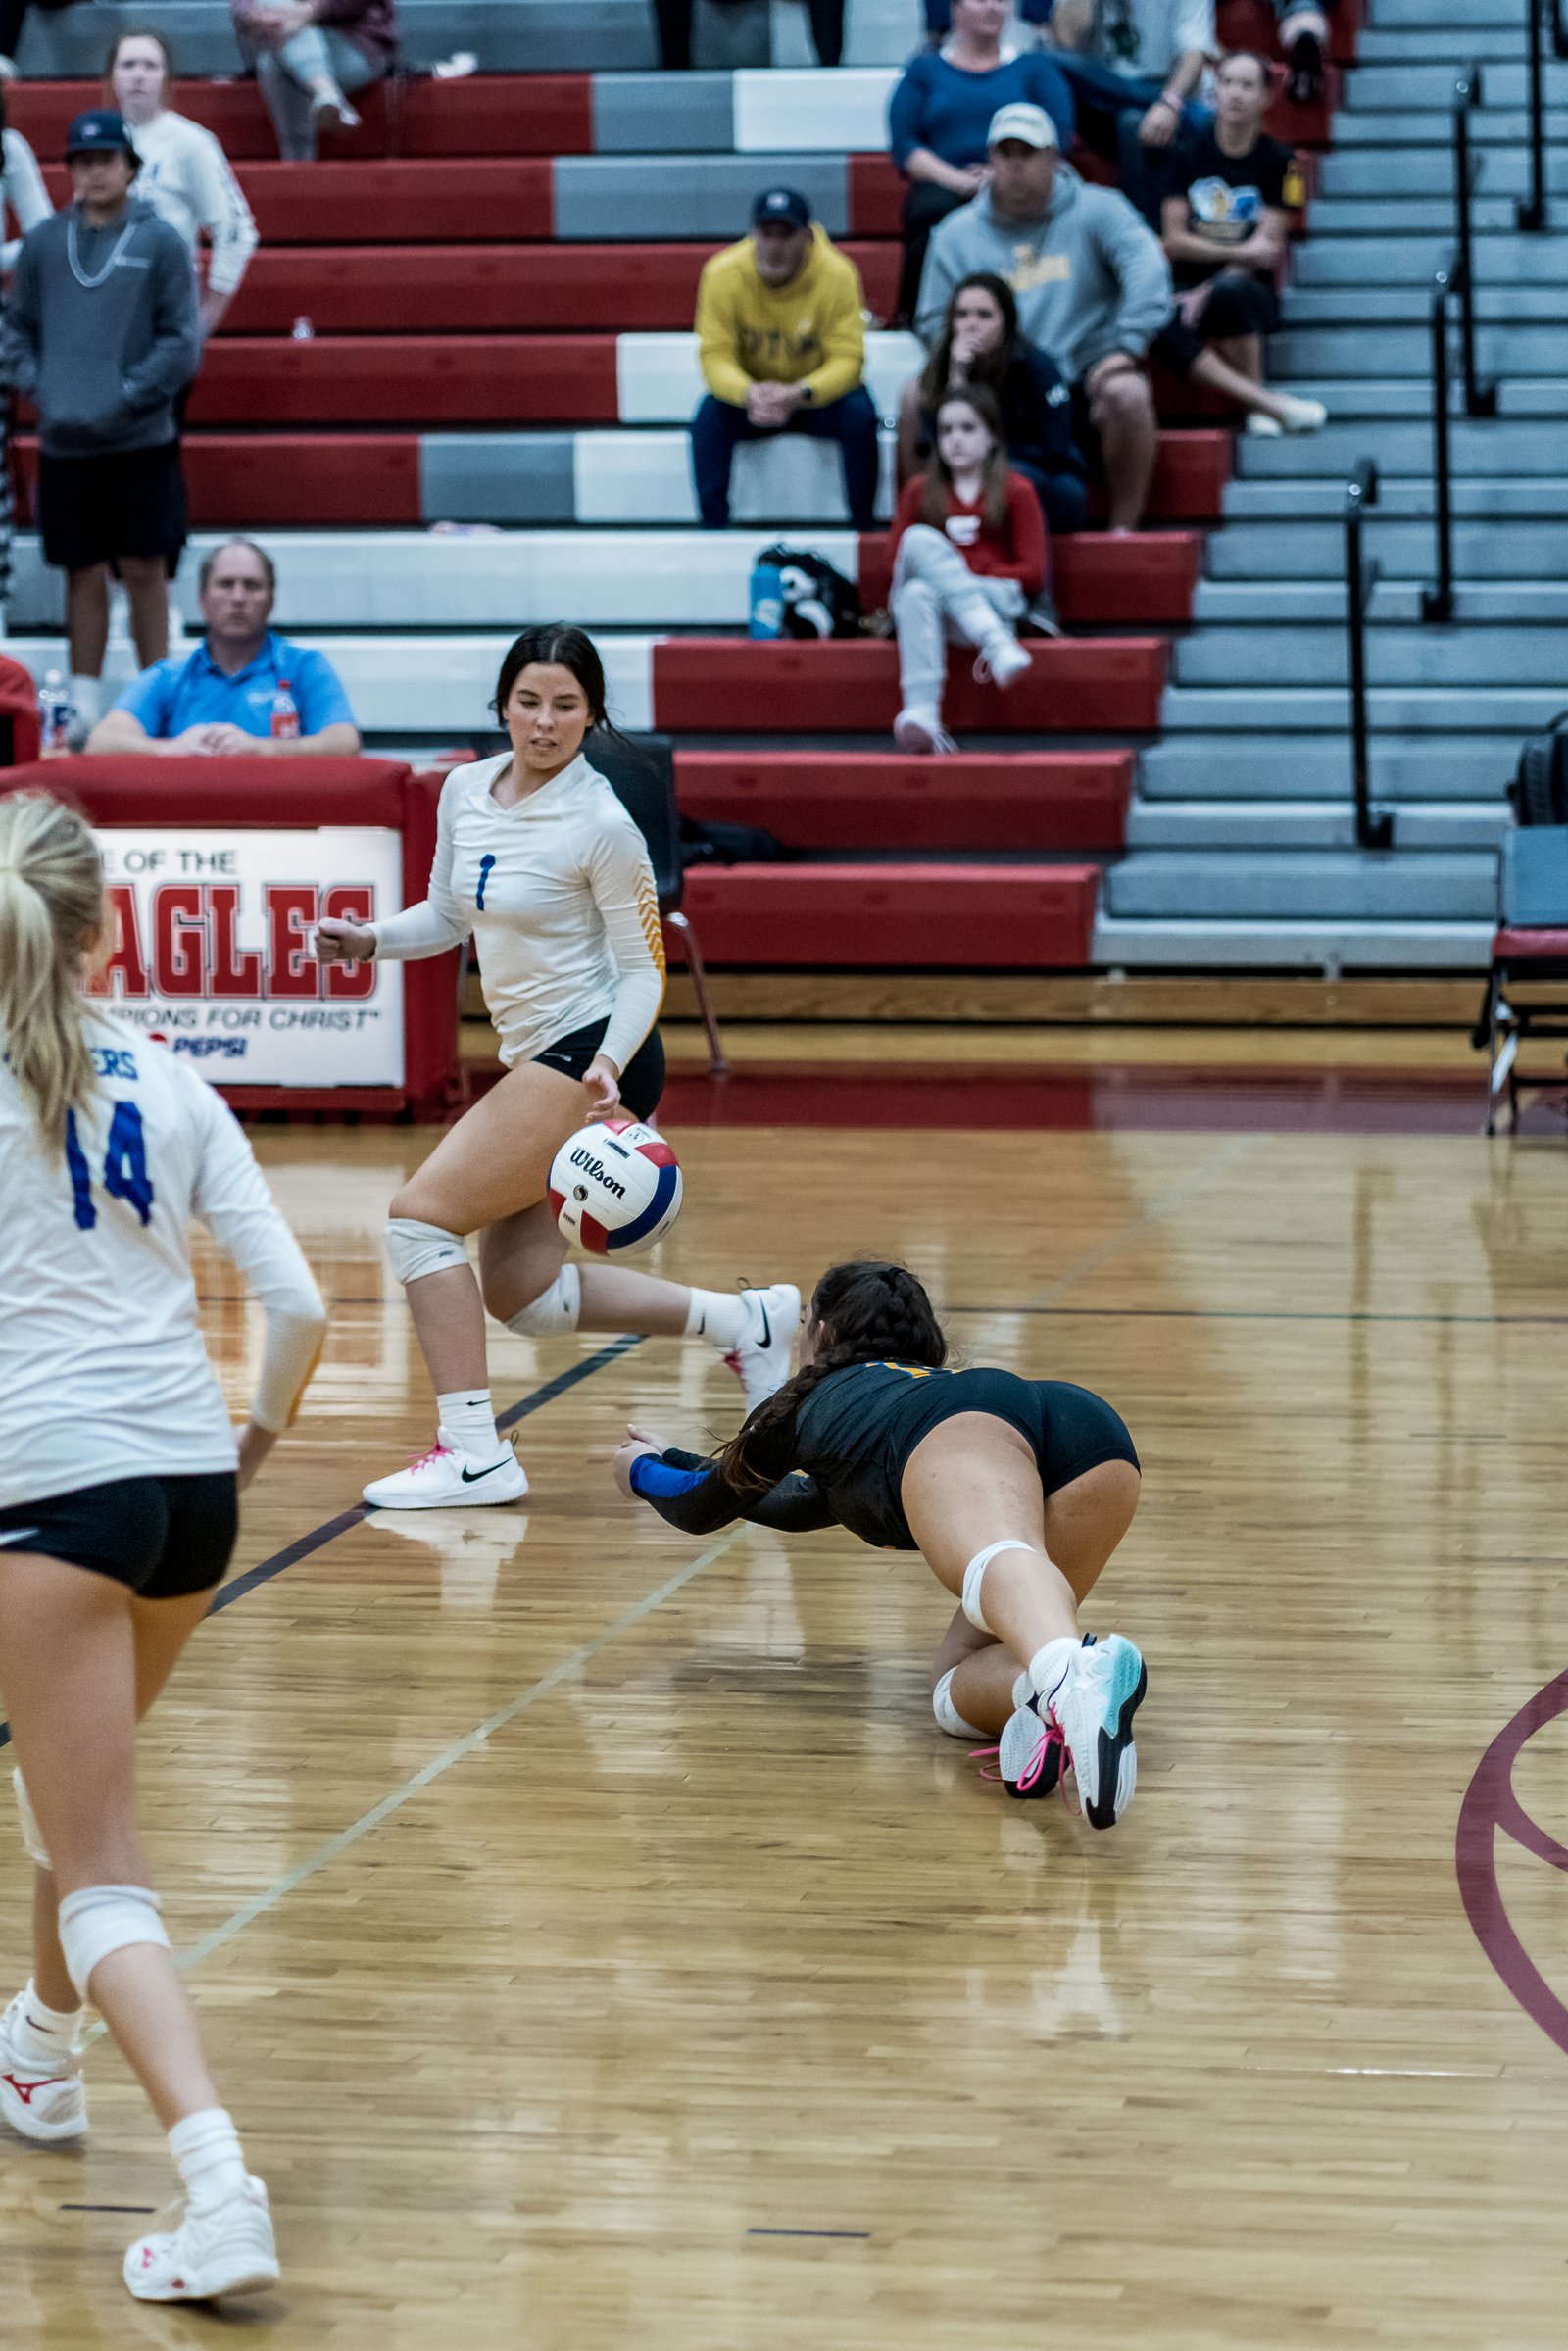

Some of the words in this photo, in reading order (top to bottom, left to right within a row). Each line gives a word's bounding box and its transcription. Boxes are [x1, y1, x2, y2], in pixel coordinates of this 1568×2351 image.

[123, 849, 167, 874] OF
[177, 849, 237, 874] THE
[475, 853, 497, 912] 1
[82, 882, 377, 1000] AGLES
[110, 1006, 198, 1029] PIONS
[207, 1007, 261, 1029] FOR
[172, 1036, 248, 1058] PEPSI
[65, 1101, 154, 1231] 14
[569, 1145, 626, 1200] Wilson
